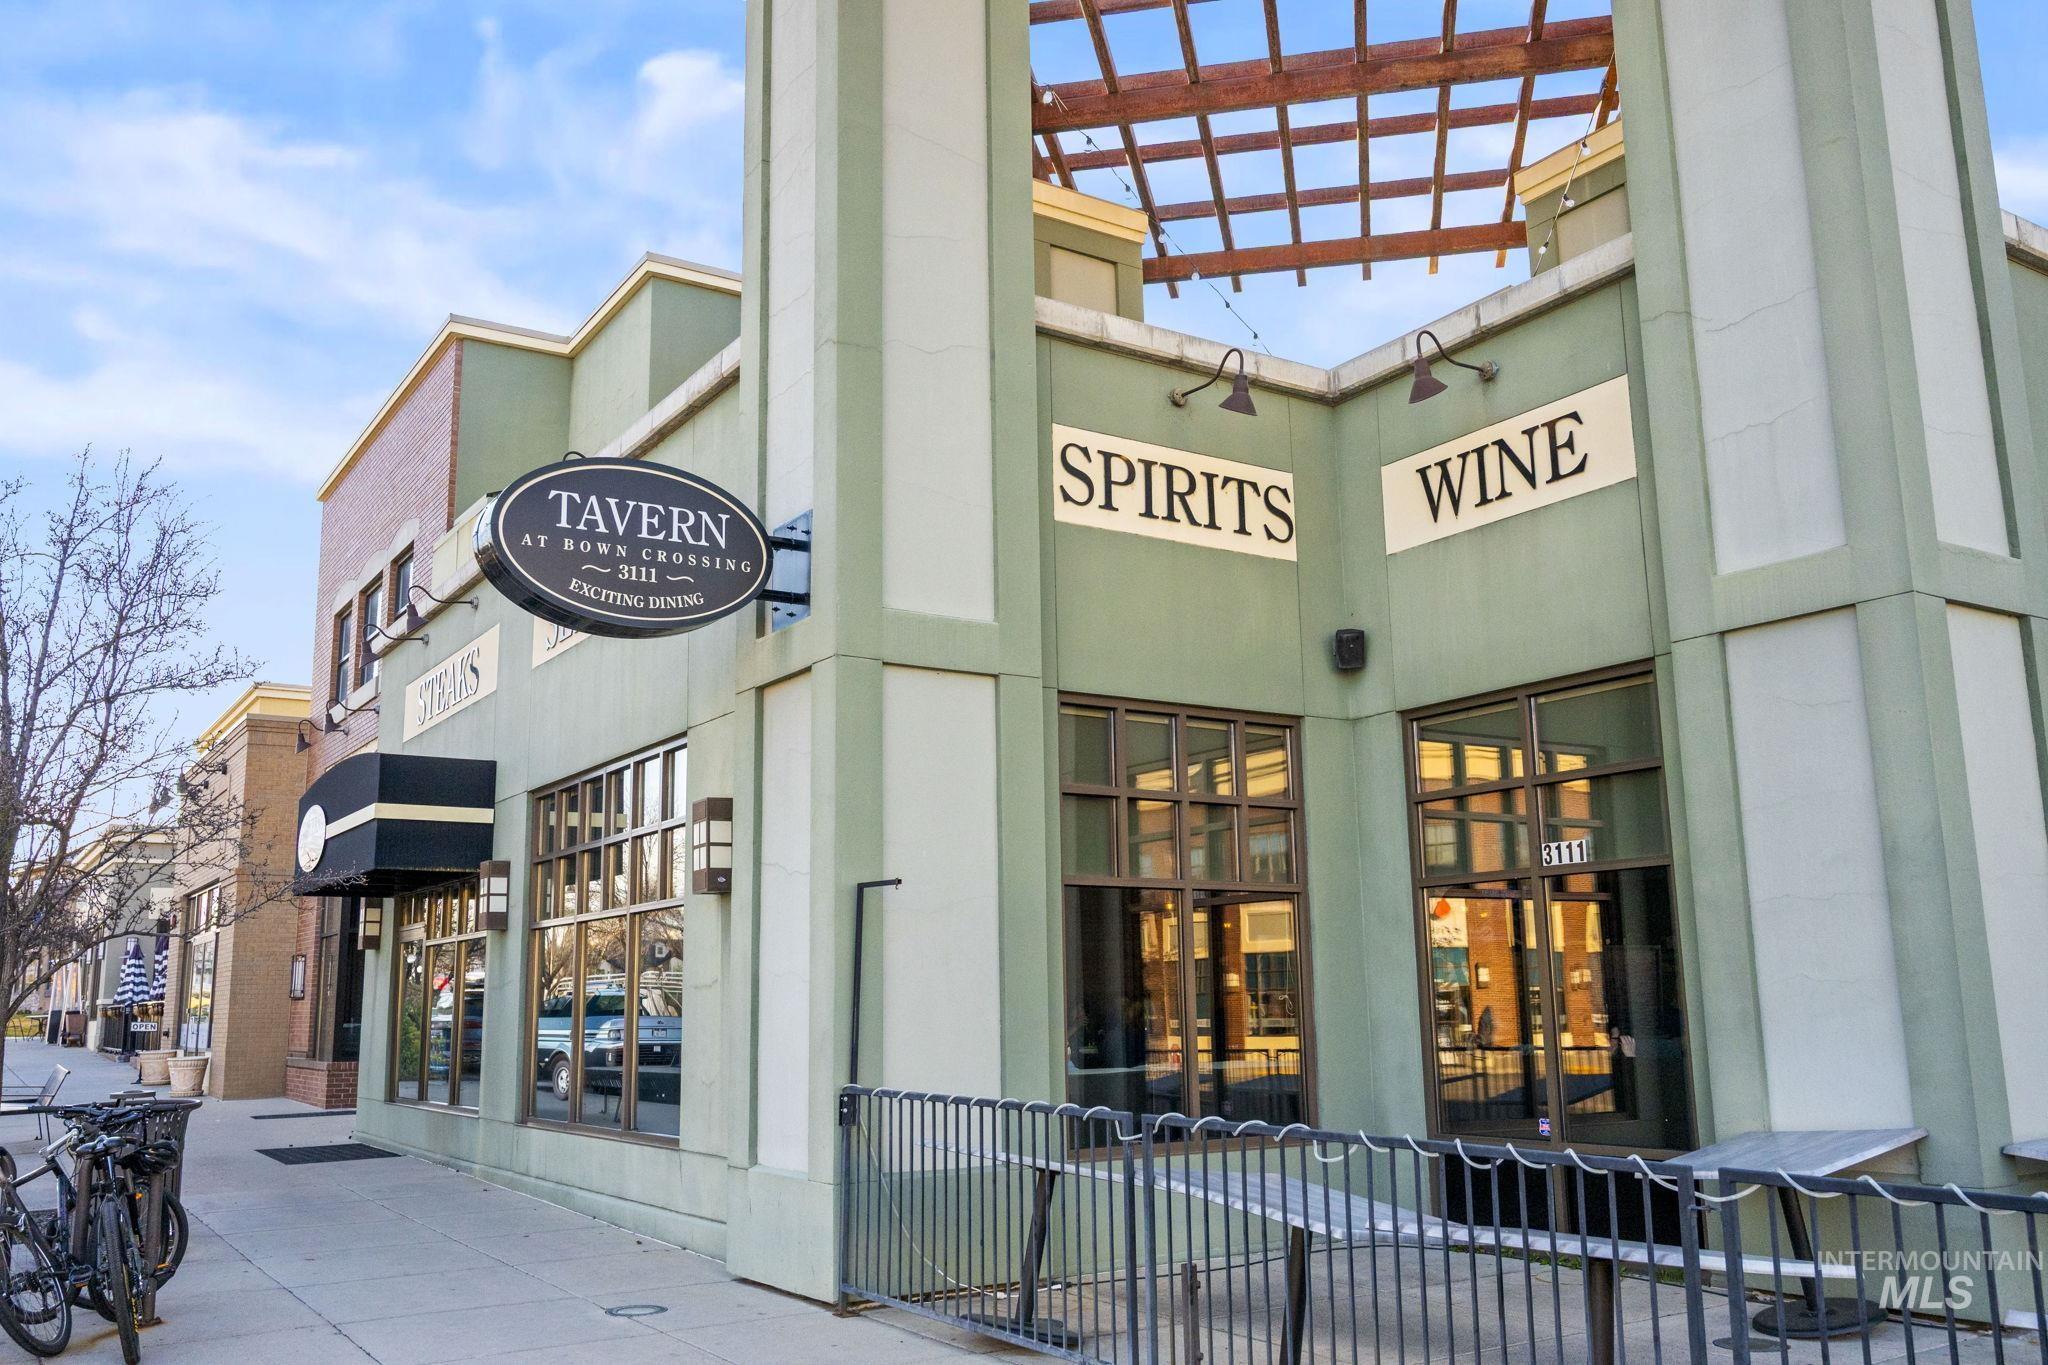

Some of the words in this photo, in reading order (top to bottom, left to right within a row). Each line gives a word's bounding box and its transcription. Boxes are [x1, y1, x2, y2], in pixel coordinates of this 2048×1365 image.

[1415, 411, 1588, 524] WINE
[1059, 443, 1295, 544] SPIRITS
[548, 489, 730, 549] TAVERN
[521, 533, 549, 547] AT
[563, 538, 628, 558] BOWN
[642, 548, 752, 573] CROSSING
[618, 564, 658, 583] 3111
[568, 577, 645, 609] EXCITING
[648, 592, 705, 609] DINING
[417, 647, 480, 726] STEAKS
[1543, 840, 1585, 865] 3111
